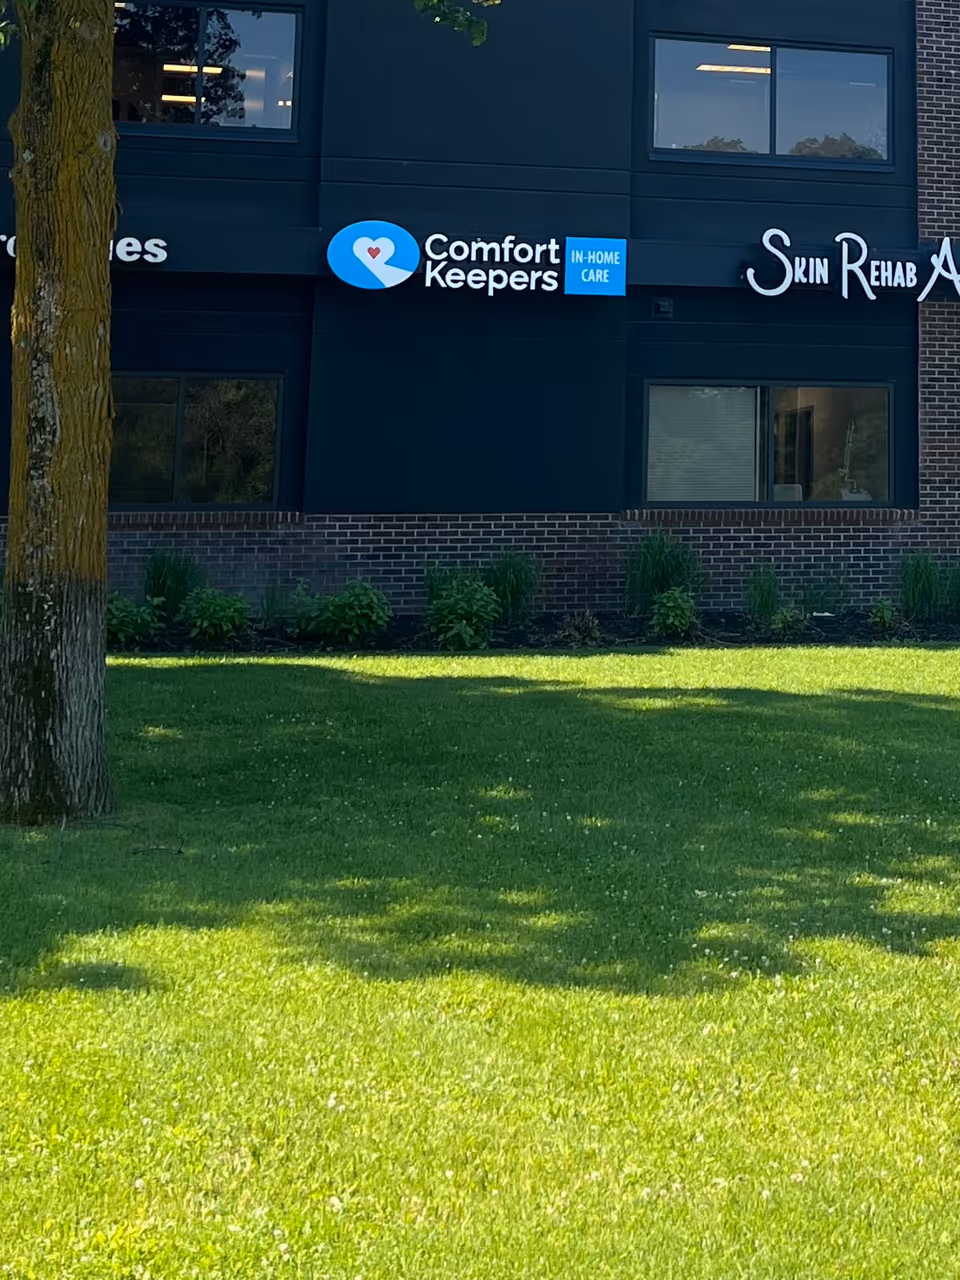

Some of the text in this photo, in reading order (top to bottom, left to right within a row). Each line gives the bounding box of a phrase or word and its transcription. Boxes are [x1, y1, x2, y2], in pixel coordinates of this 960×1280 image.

[425, 233, 561, 264] Comfort
[571, 250, 621, 265] IN-HOME
[747, 228, 829, 296] SKIN
[834, 232, 918, 300] REHAB
[425, 261, 559, 296] Keepers
[581, 269, 610, 283] CARE
